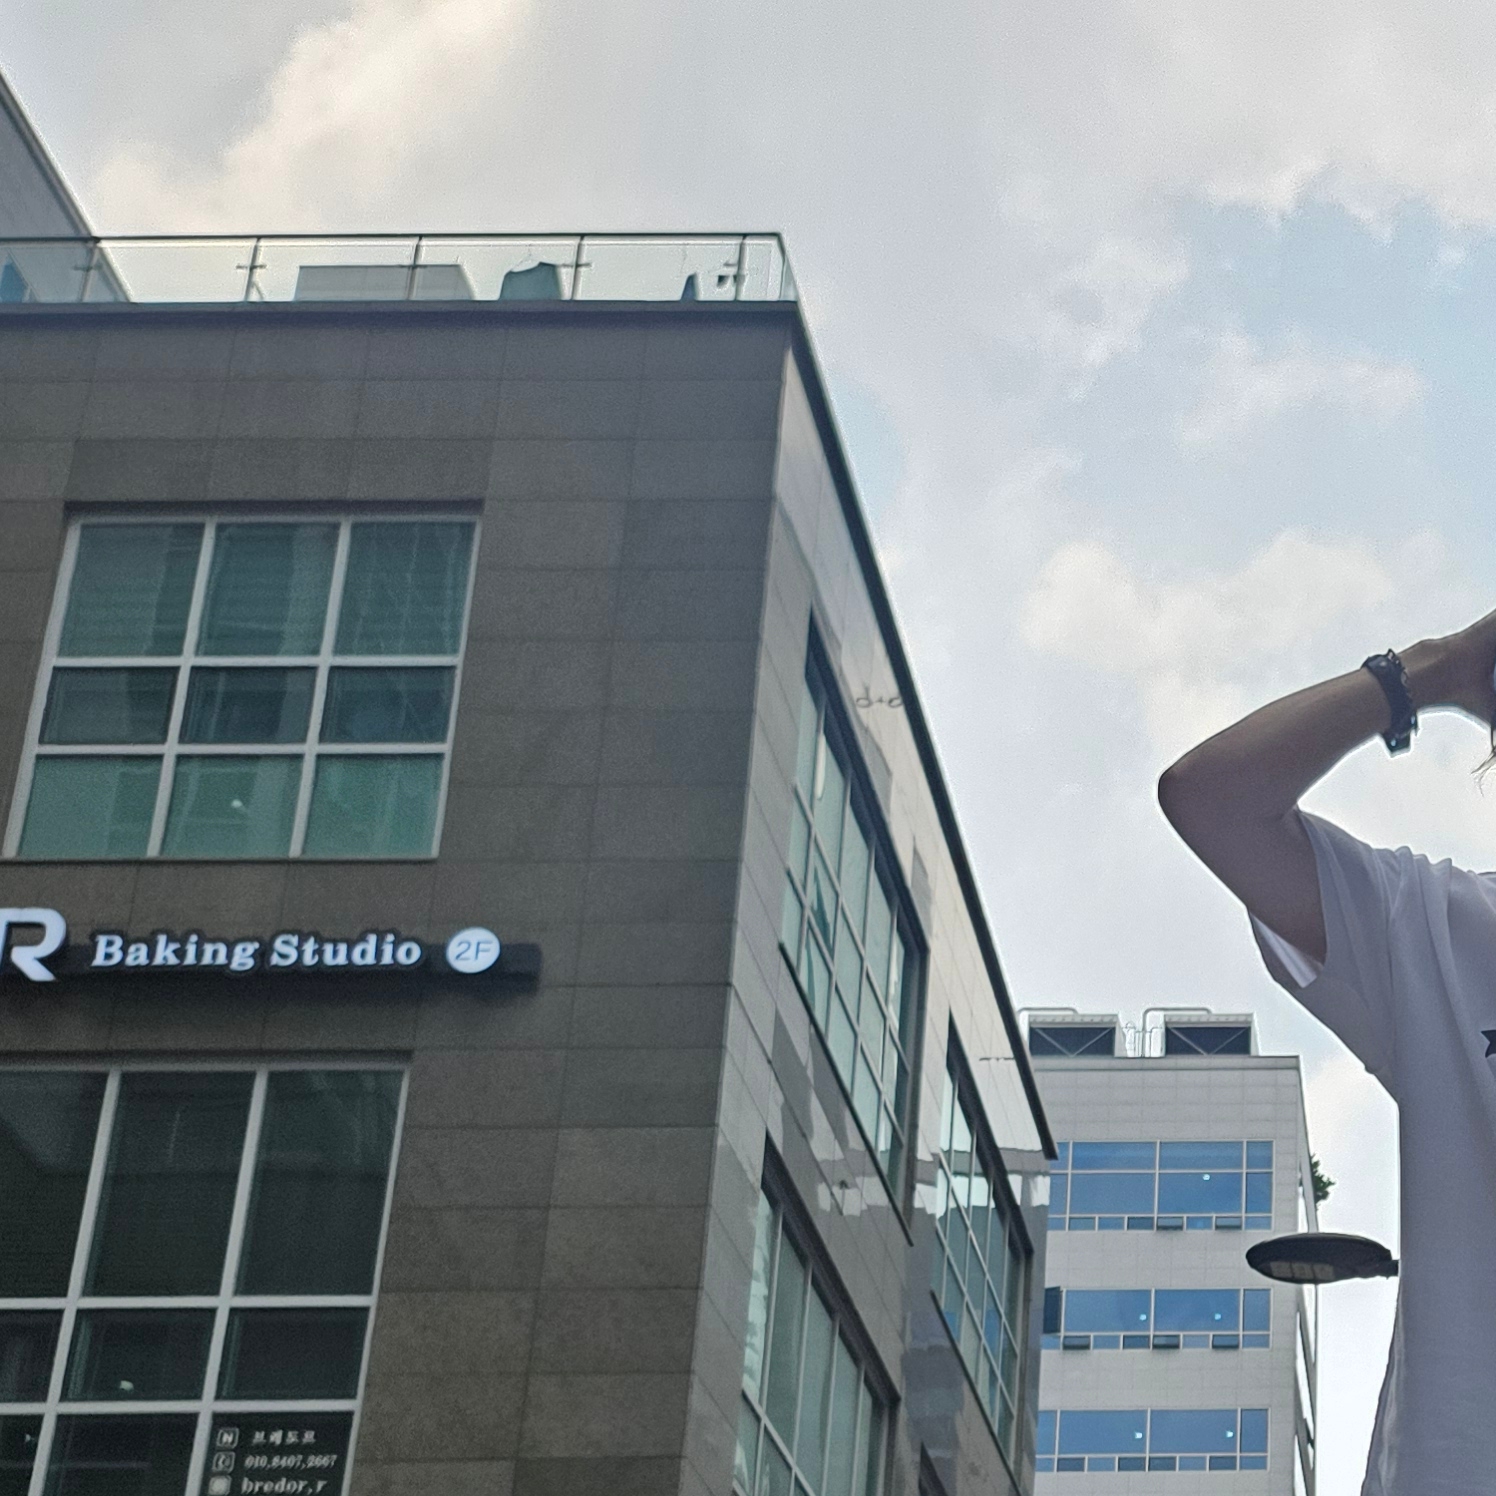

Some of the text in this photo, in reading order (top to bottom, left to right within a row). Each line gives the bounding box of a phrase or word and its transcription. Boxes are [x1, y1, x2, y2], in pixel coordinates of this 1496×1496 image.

[91, 934, 260, 973] Baking
[269, 934, 422, 967] Studio
[454, 941, 494, 962] 2F
